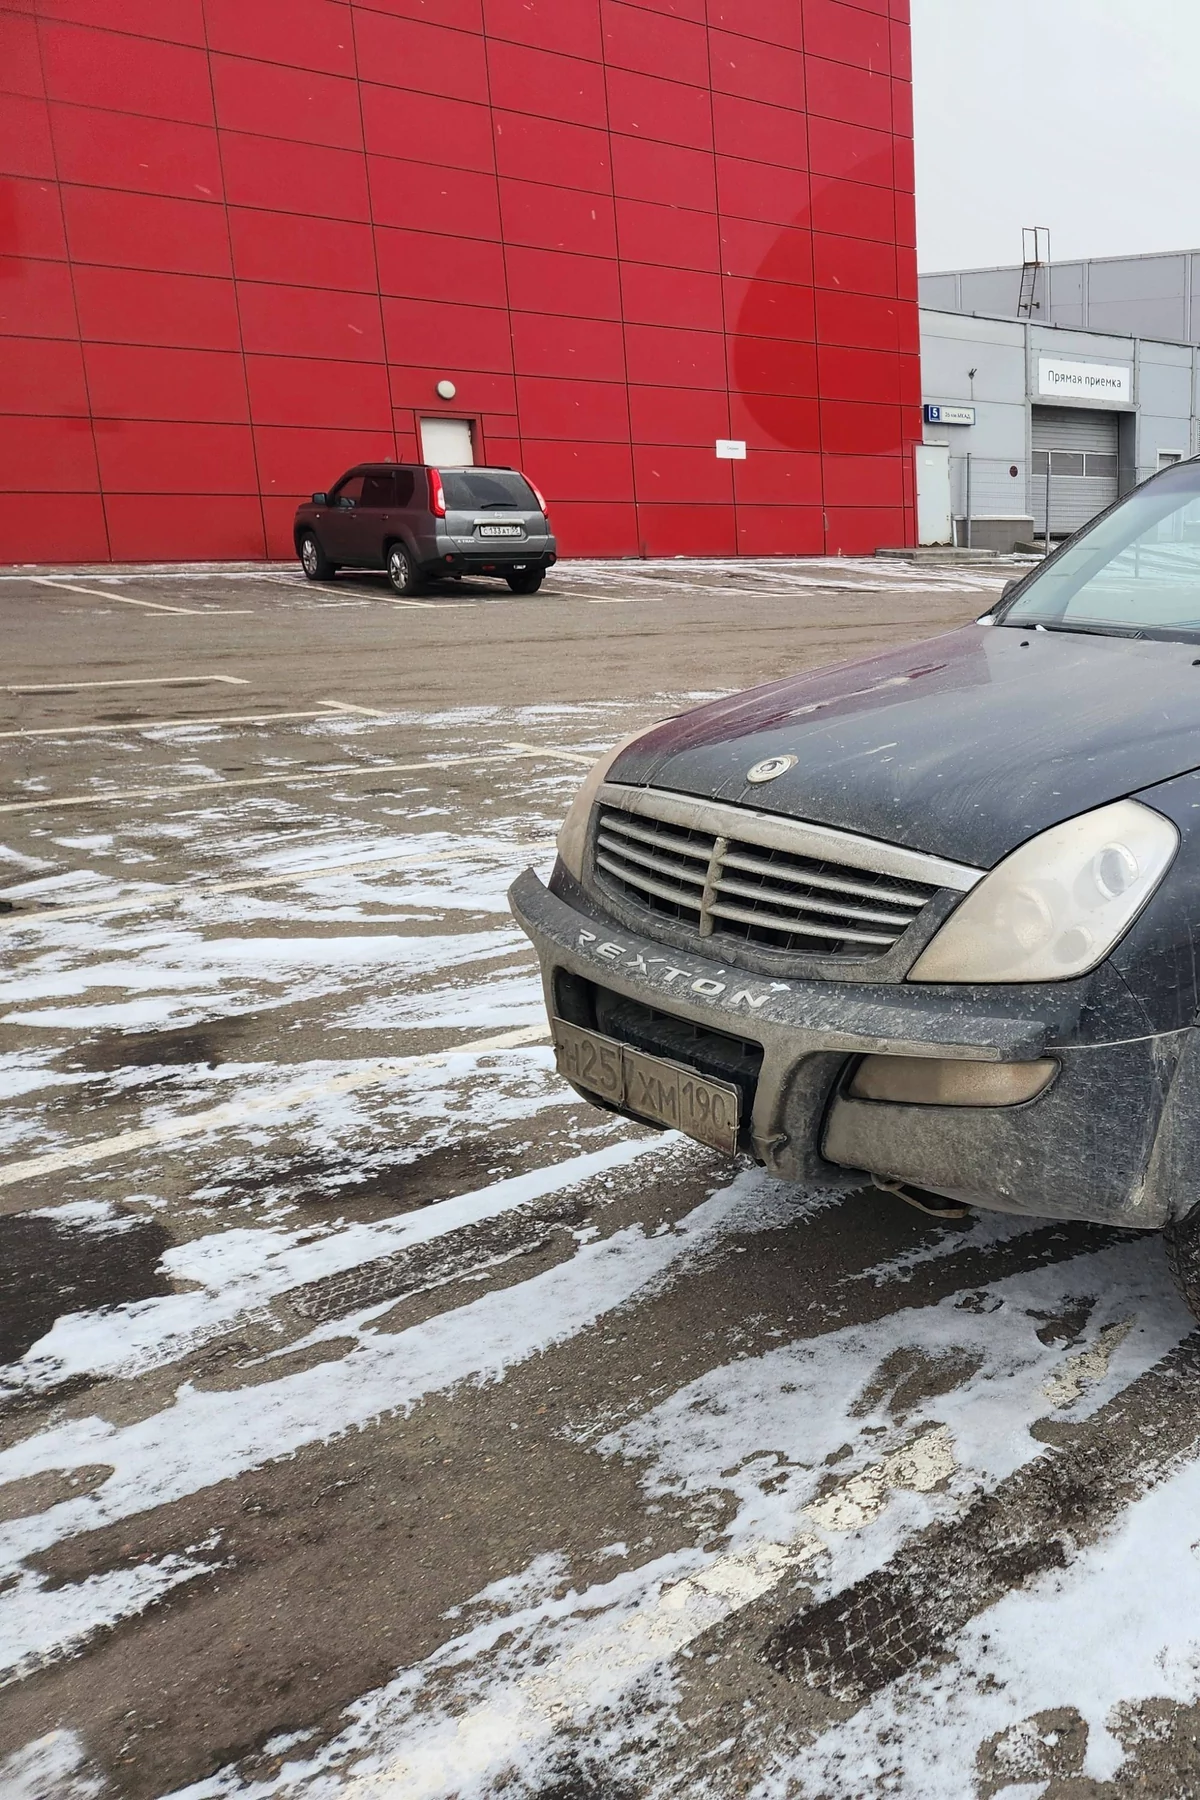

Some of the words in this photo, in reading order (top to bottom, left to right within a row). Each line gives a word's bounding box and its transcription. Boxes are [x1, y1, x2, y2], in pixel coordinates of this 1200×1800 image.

[1048, 370, 1082, 384] Прямая
[1085, 376, 1121, 388] приемка
[932, 408, 938, 417] 5
[578, 928, 771, 1009] REXTON
